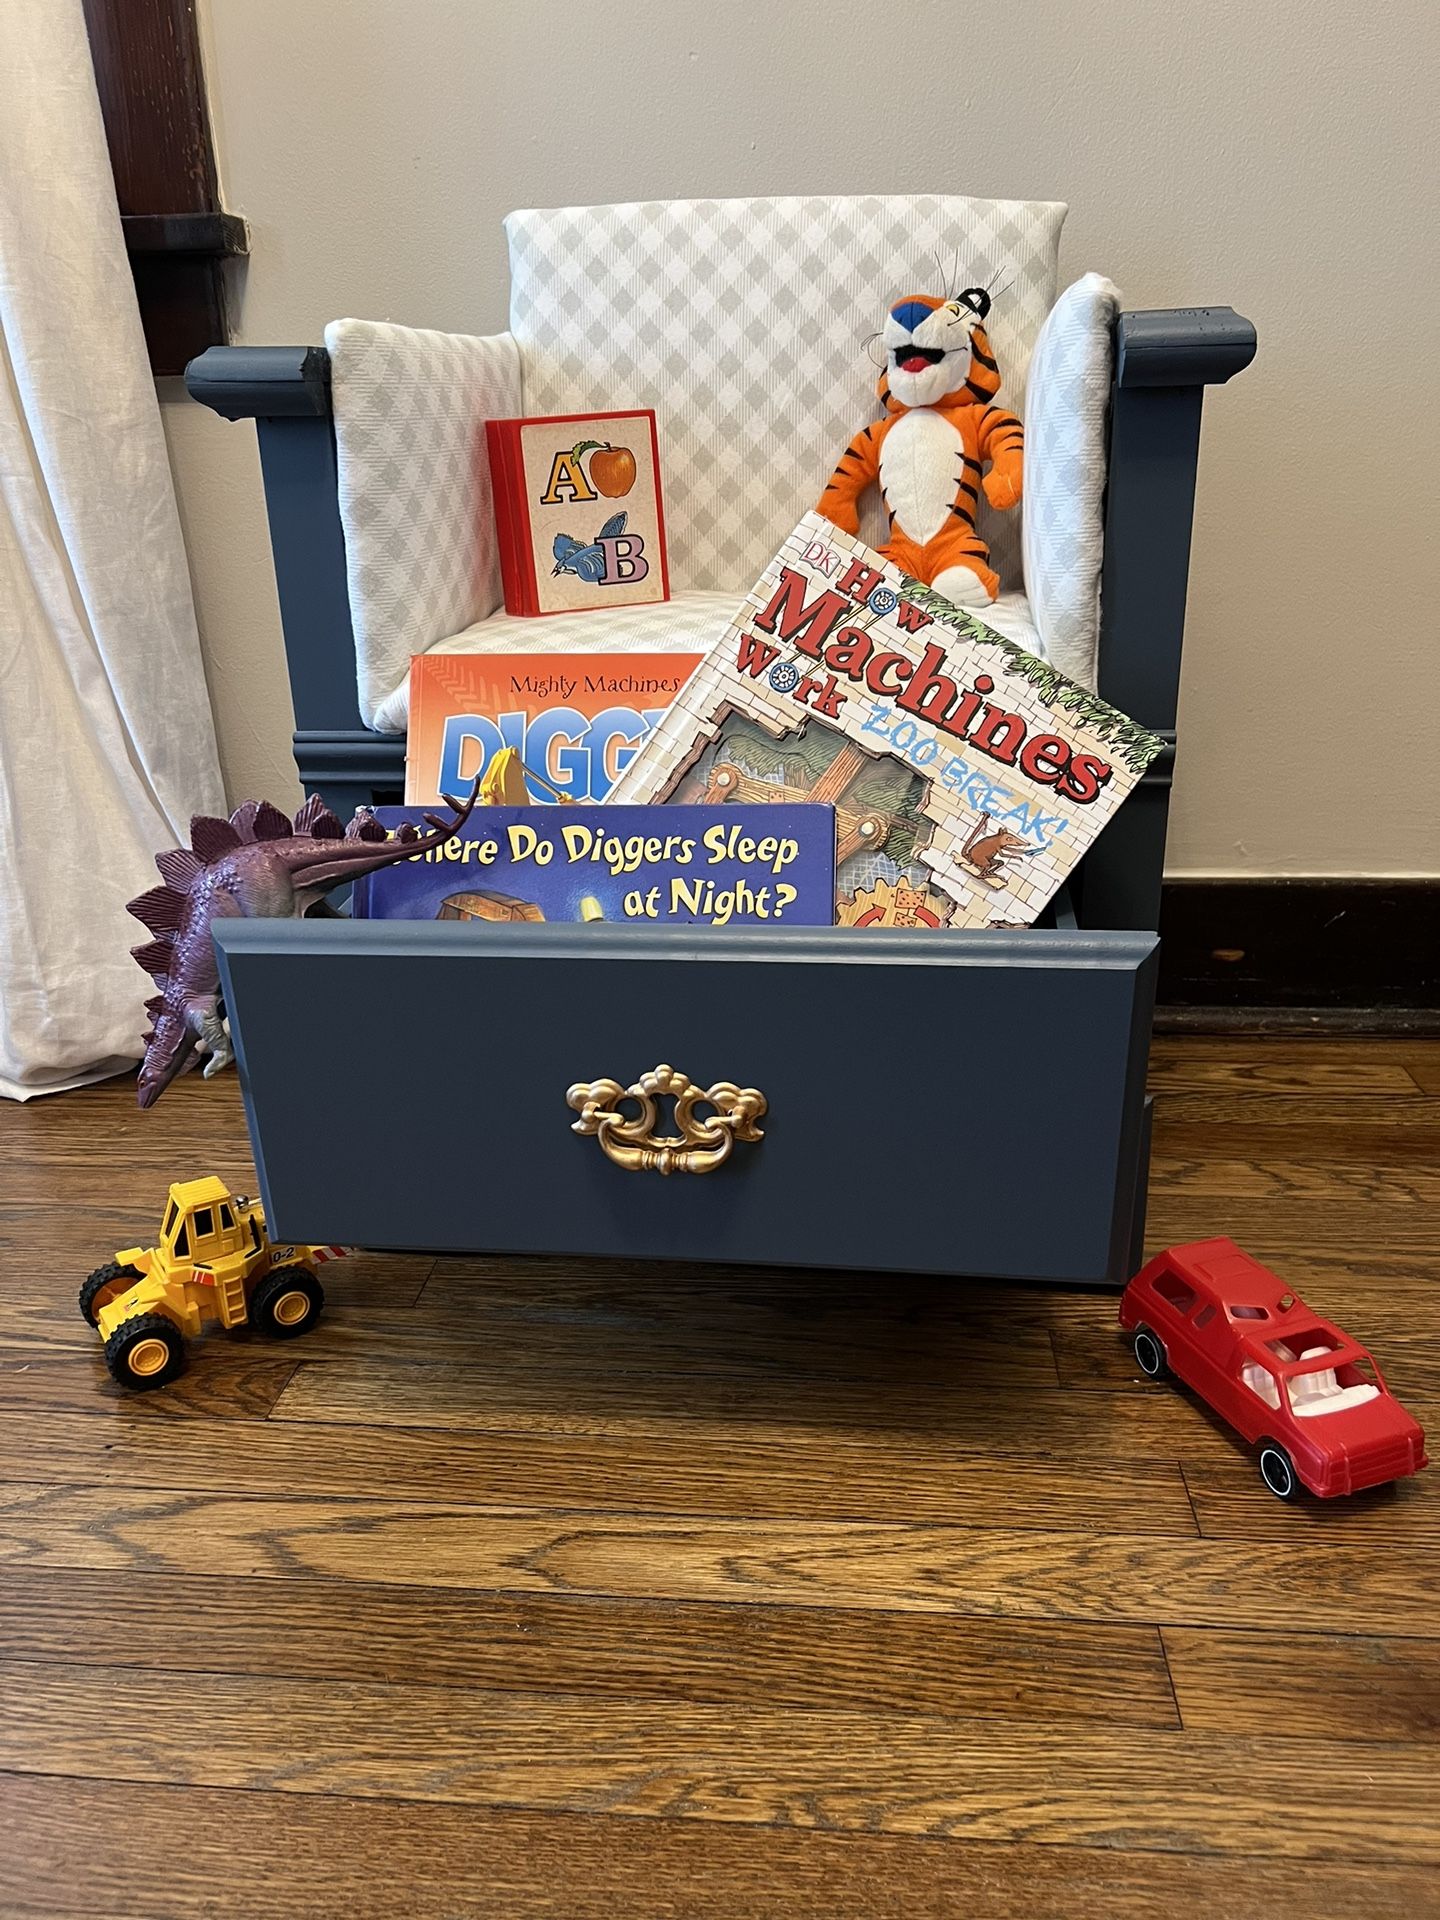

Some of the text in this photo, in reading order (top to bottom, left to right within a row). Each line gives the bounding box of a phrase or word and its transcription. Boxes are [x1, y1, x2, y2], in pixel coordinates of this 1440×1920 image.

[540, 450, 598, 505] A
[594, 534, 649, 585] B
[836, 557, 933, 634] How
[510, 675, 681, 699] Mighty Machines
[737, 634, 848, 719] Work
[755, 568, 1114, 804] Machines
[861, 704, 1069, 844] ZOO BREAK!
[507, 825, 554, 866] Do
[561, 825, 697, 876] Diggers
[702, 824, 800, 874] Sleep
[623, 877, 798, 925] at Night?
